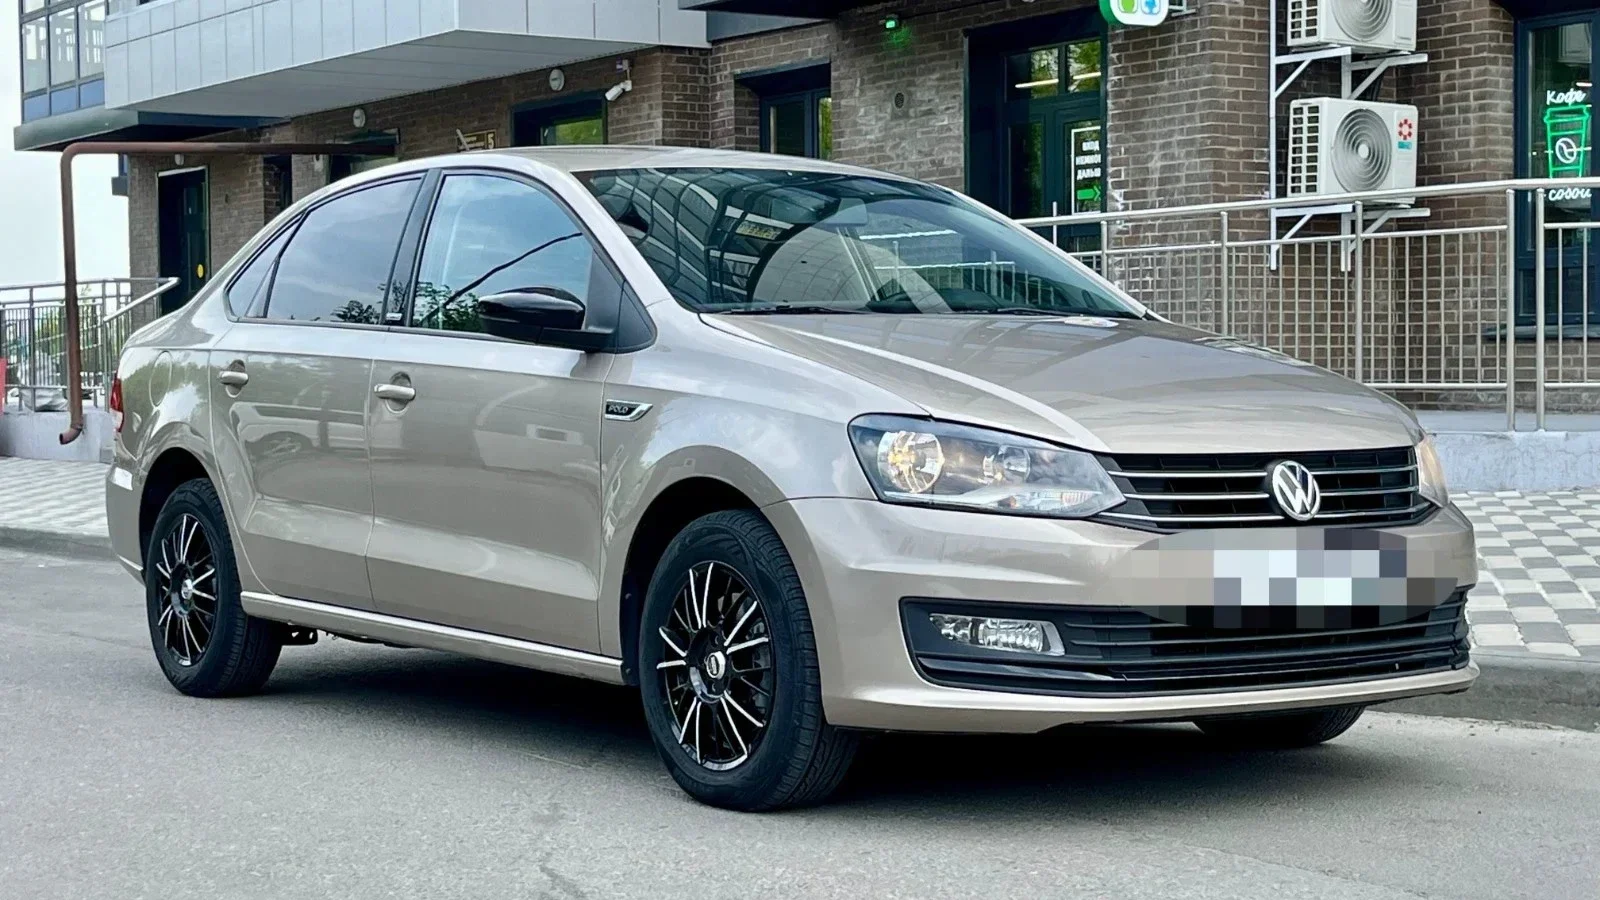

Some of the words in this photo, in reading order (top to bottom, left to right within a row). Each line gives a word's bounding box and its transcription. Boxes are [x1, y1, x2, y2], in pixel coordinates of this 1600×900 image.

[1546, 88, 1586, 106] Кофе
[487, 133, 495, 149] 5
[1076, 168, 1101, 180] ДАЛЬШ
[608, 404, 629, 414] POLO
